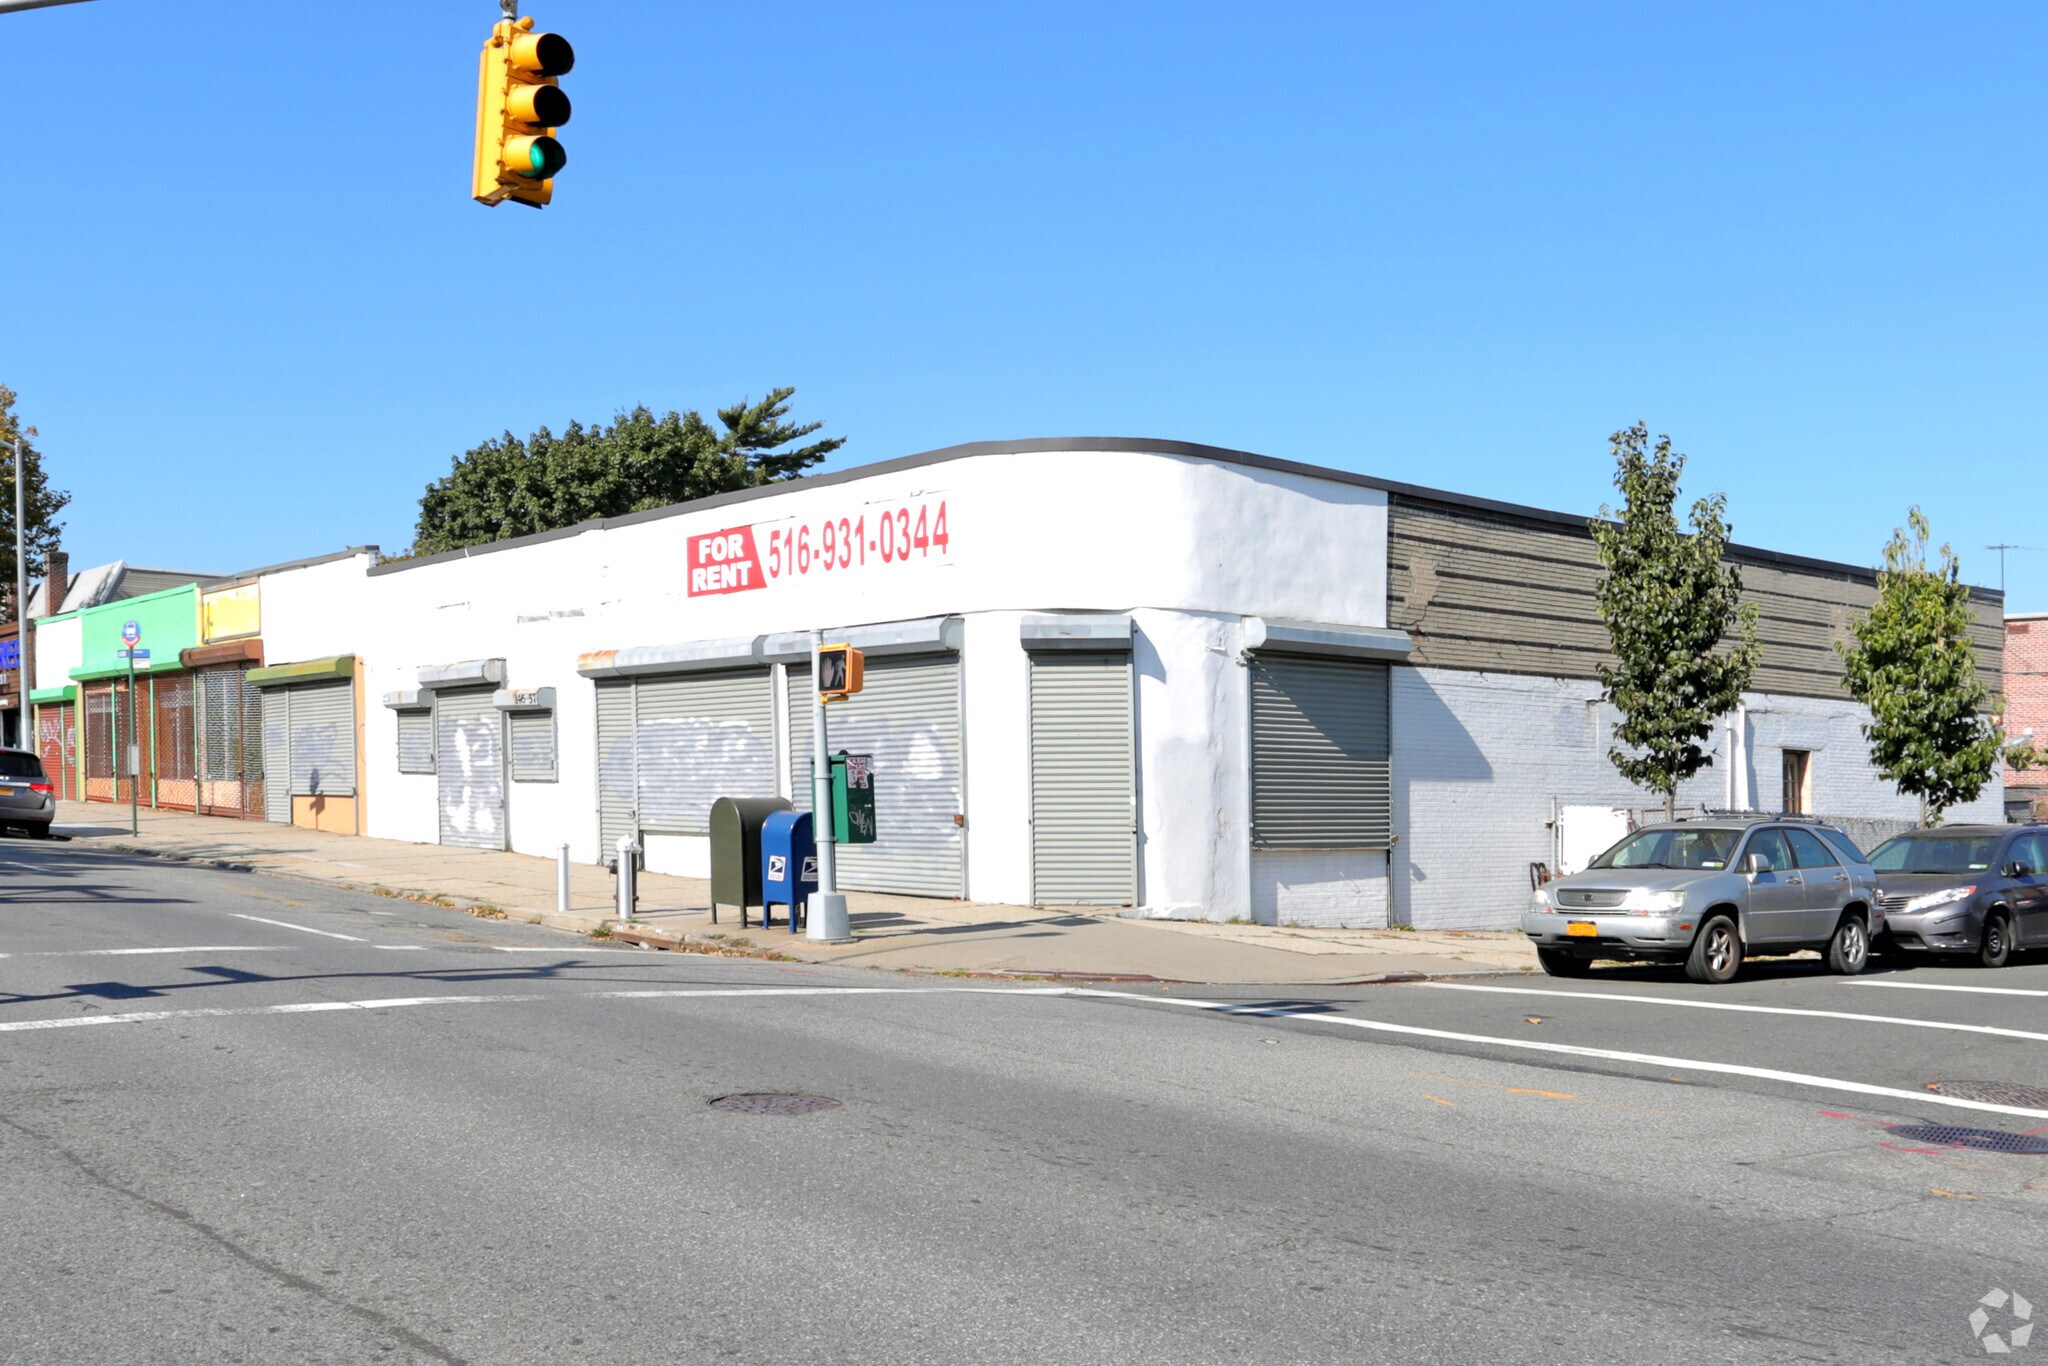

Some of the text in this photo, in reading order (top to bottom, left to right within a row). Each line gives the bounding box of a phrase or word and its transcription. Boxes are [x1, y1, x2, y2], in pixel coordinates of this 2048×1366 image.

[698, 533, 745, 564] FOR
[768, 500, 949, 579] 516-931-0344
[691, 560, 753, 593] RENT
